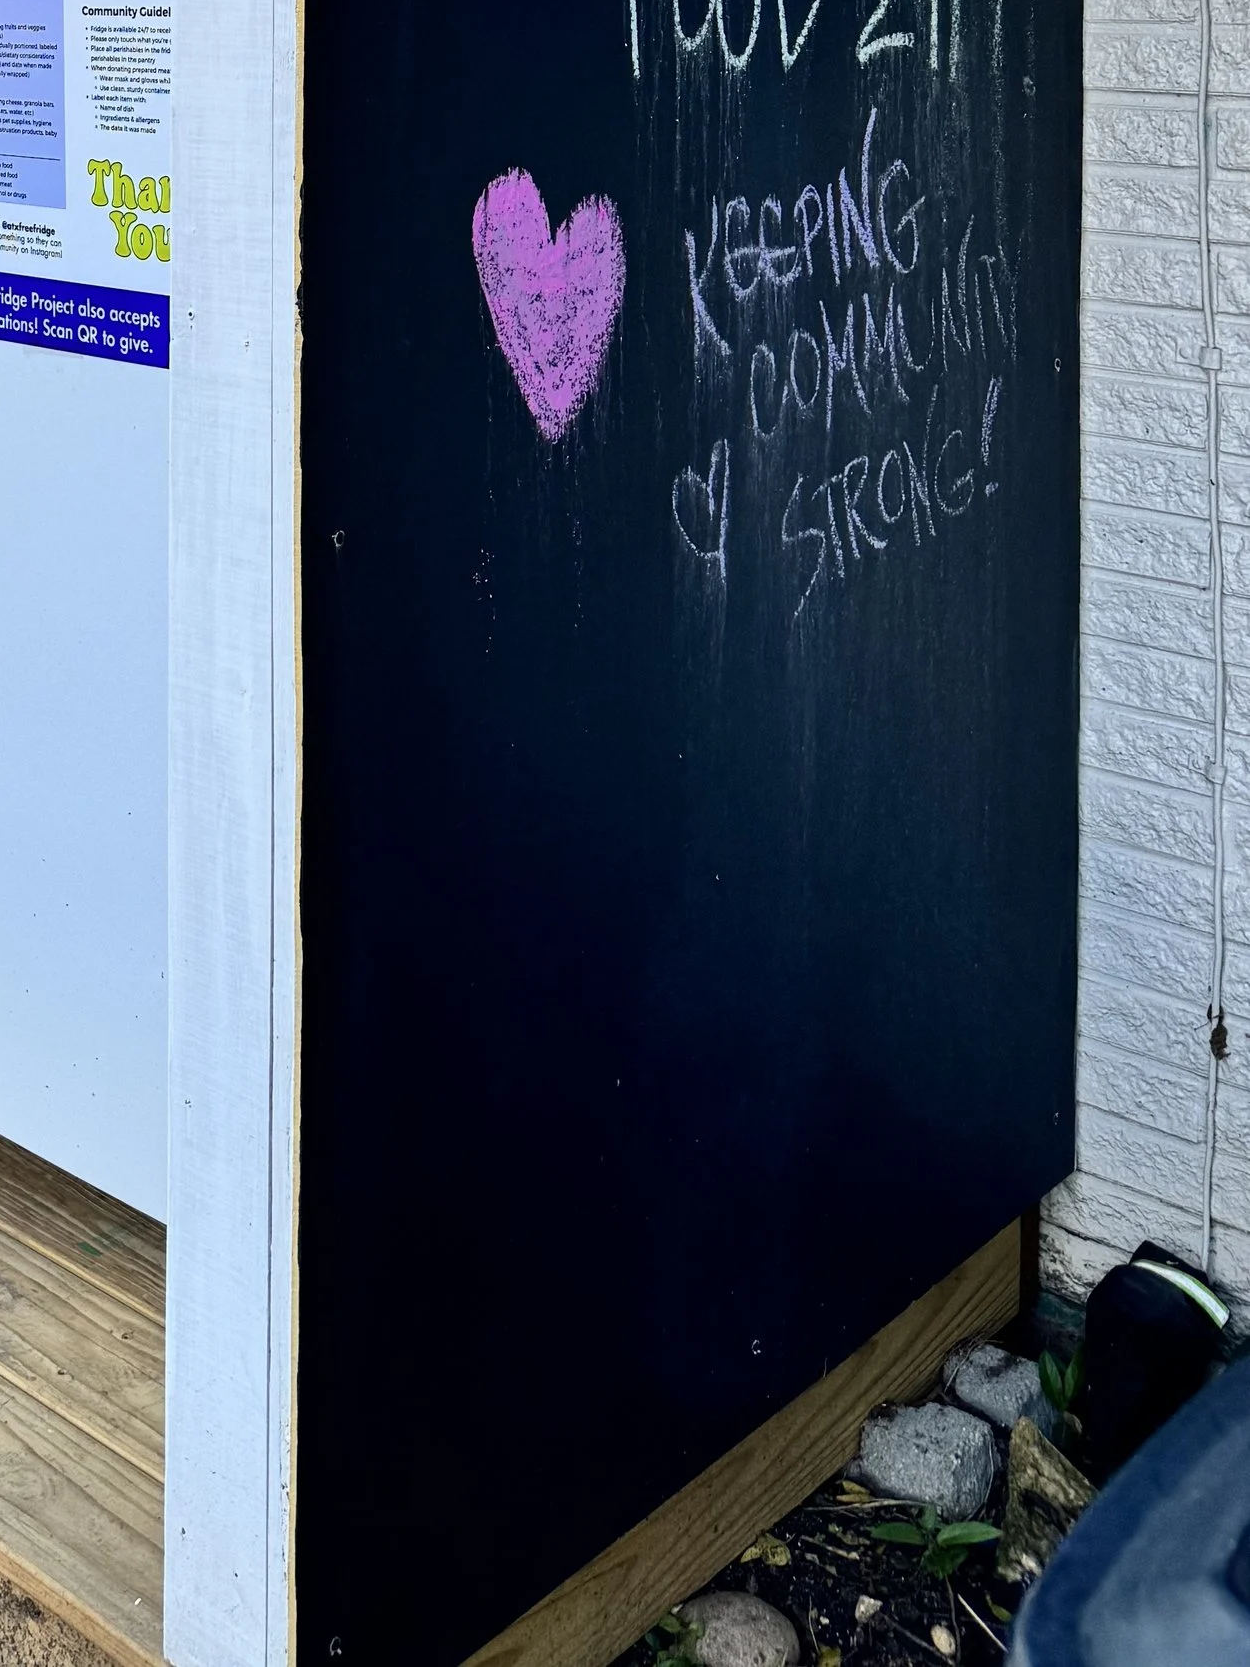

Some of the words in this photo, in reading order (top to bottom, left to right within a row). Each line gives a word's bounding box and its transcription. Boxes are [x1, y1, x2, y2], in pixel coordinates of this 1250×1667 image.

[82, 6, 137, 18] Community
[140, 7, 171, 17] Guidel
[2, 221, 55, 237] @atxfreefridge
[684, 107, 925, 356] KEEPING
[30, 246, 62, 259] Instagram!
[35, 237, 48, 247] they
[31, 292, 74, 317] Project
[78, 298, 105, 320] also
[110, 308, 161, 331] accepts
[43, 320, 73, 340] Scan
[78, 325, 98, 345] QR
[103, 332, 115, 346] to
[120, 336, 153, 354] give.
[781, 374, 1002, 618] STRONG!
